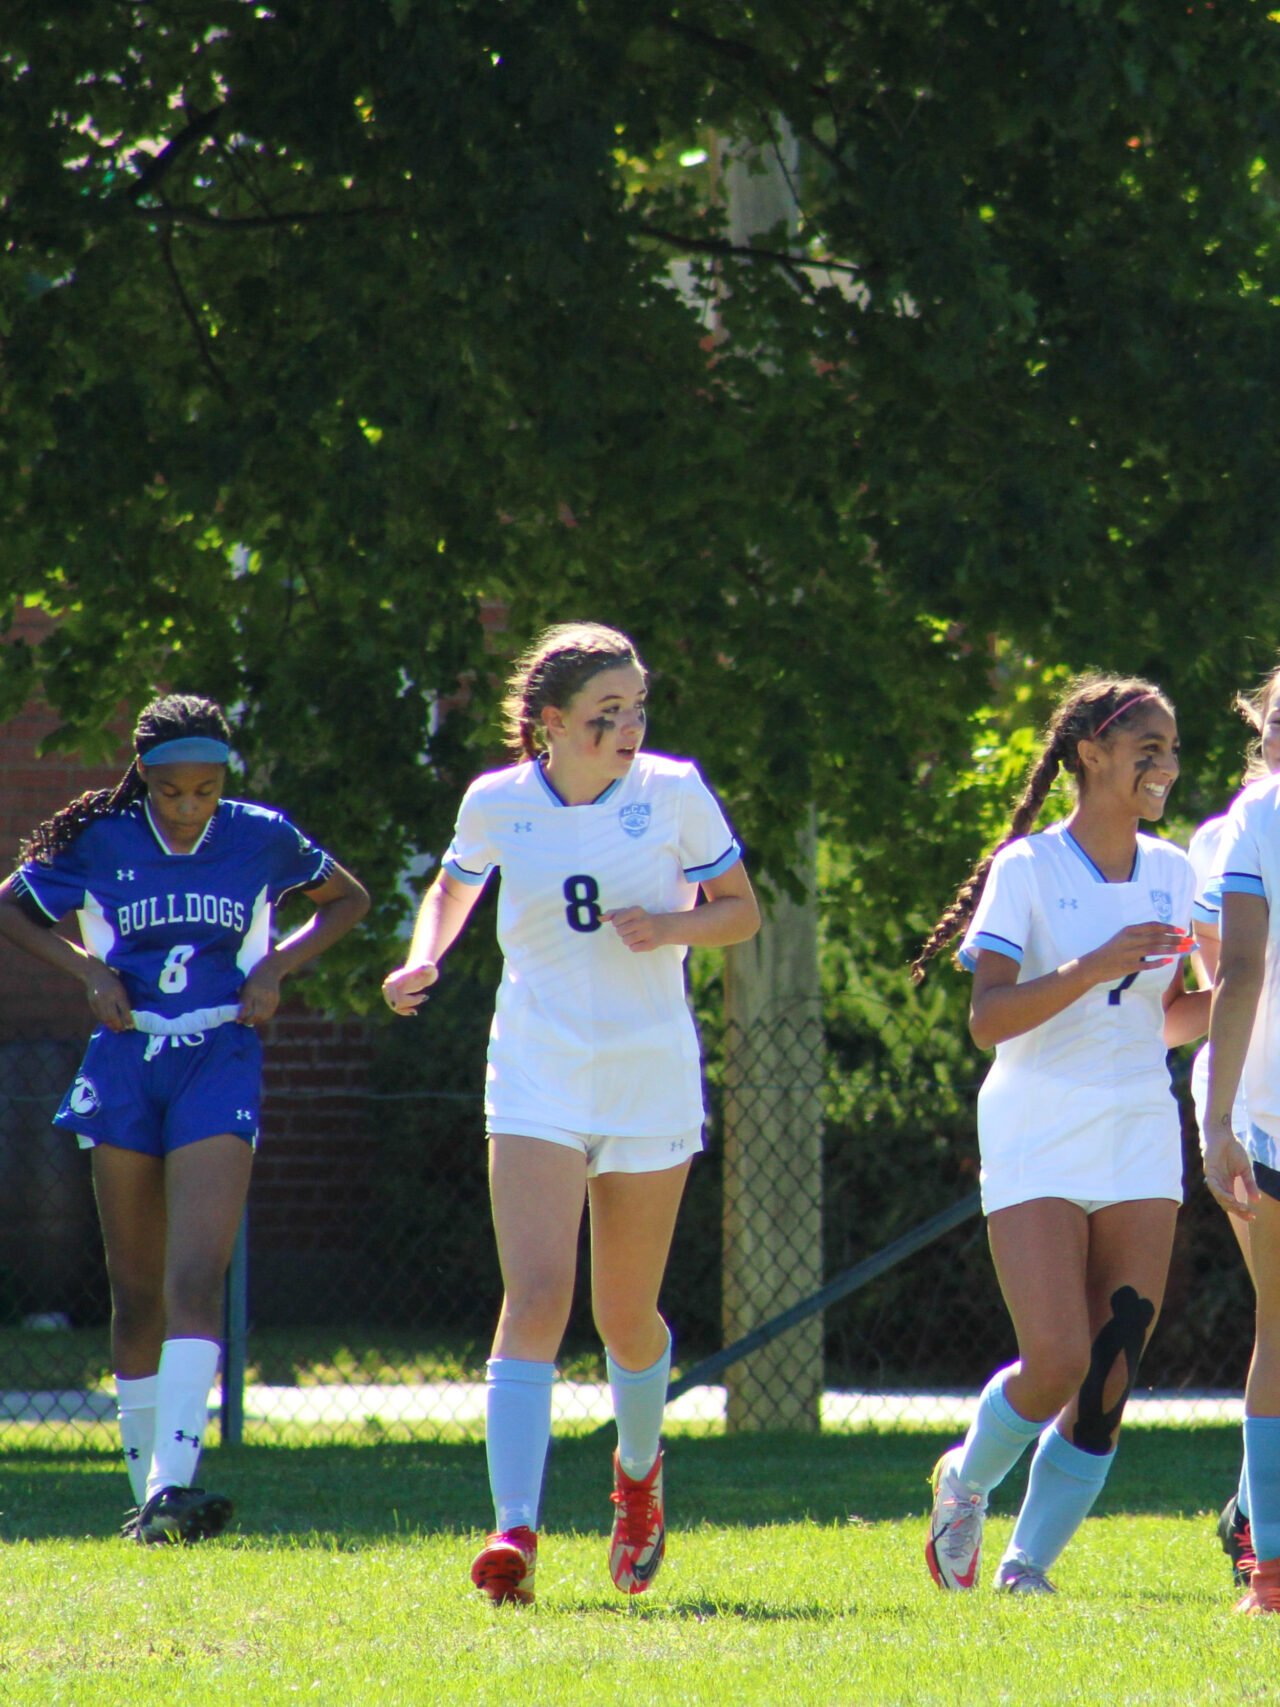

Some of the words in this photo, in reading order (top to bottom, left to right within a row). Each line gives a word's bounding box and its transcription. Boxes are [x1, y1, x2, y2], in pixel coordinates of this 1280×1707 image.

[117, 892, 245, 937] BULLDOGS
[562, 874, 602, 933] 8
[158, 945, 195, 994] 8
